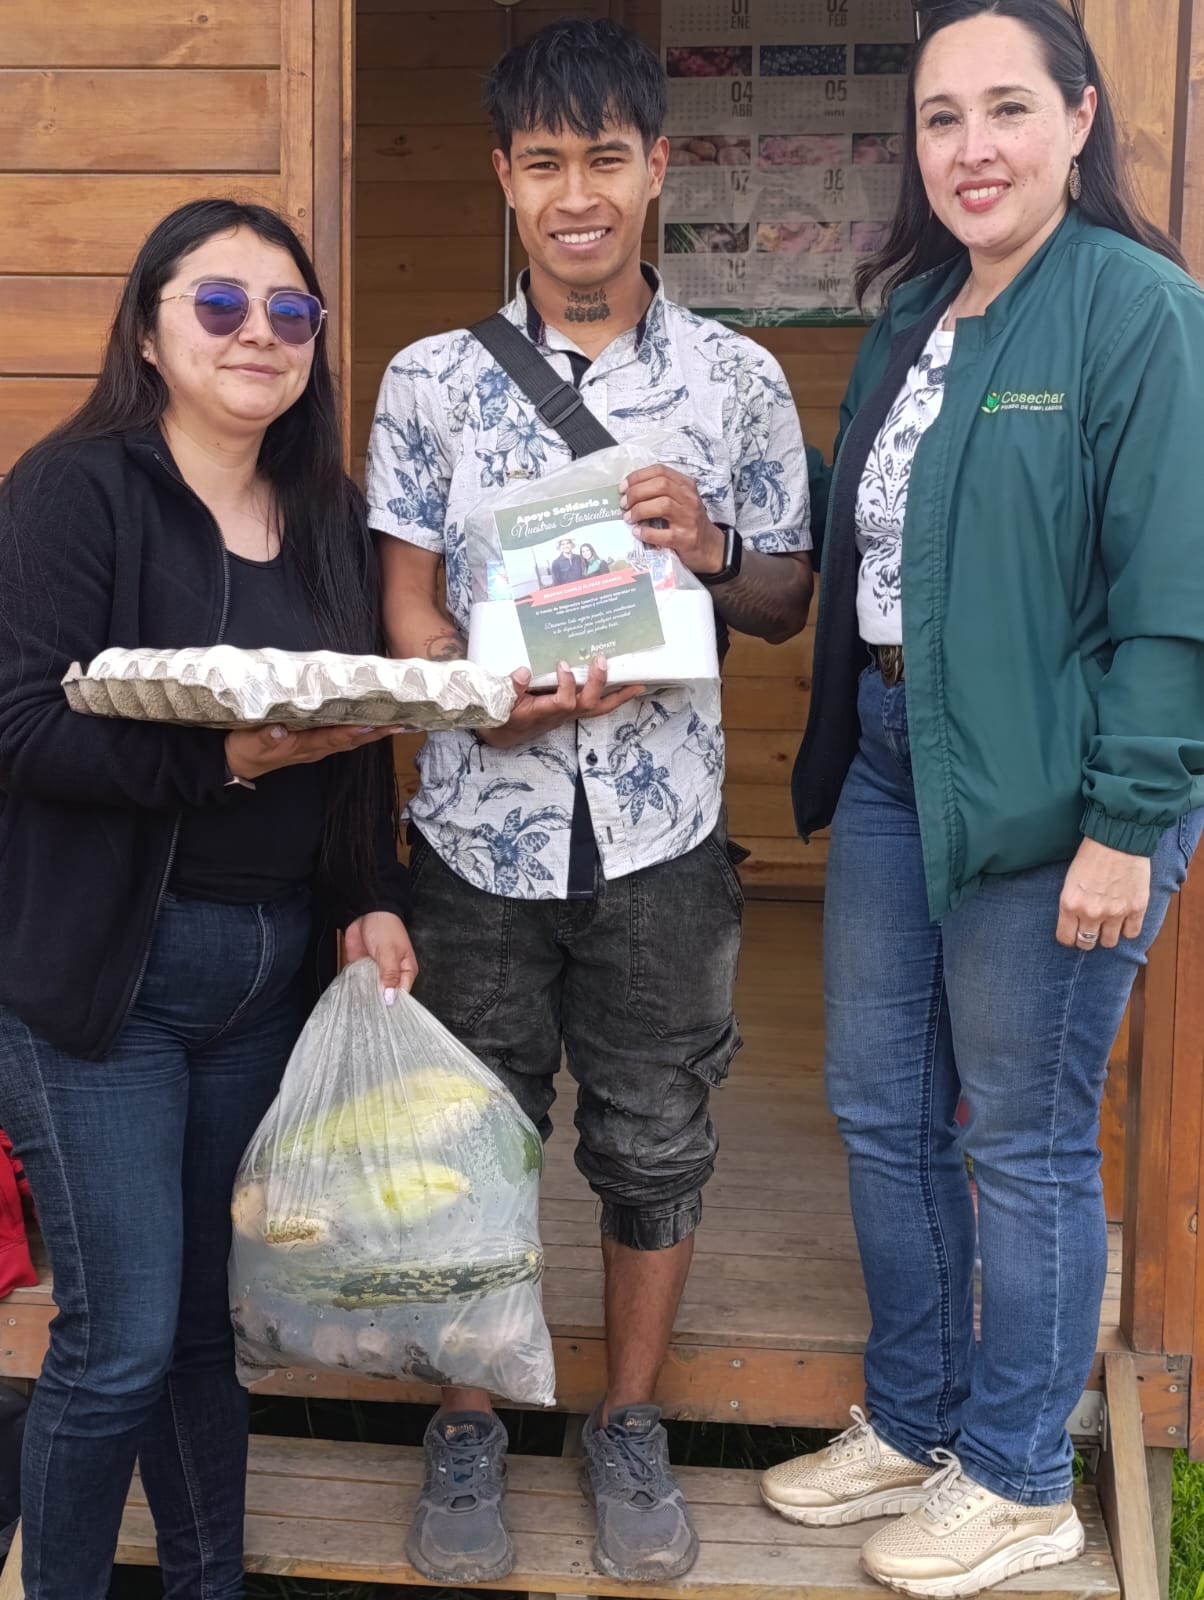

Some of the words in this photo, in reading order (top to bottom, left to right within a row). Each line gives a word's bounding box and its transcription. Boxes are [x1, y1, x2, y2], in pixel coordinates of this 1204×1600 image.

[731, 16, 751, 30] ENE
[828, 14, 848, 28] FEB
[731, 81, 753, 103] 04
[825, 80, 848, 102] 05
[731, 104, 752, 118] ABR
[818, 278, 841, 293] NOV
[1001, 391, 1065, 404] Cosechar
[516, 510, 551, 525] Apoyo
[552, 498, 601, 516] Solidario
[602, 498, 609, 506] a
[510, 520, 558, 538] Nuestros
